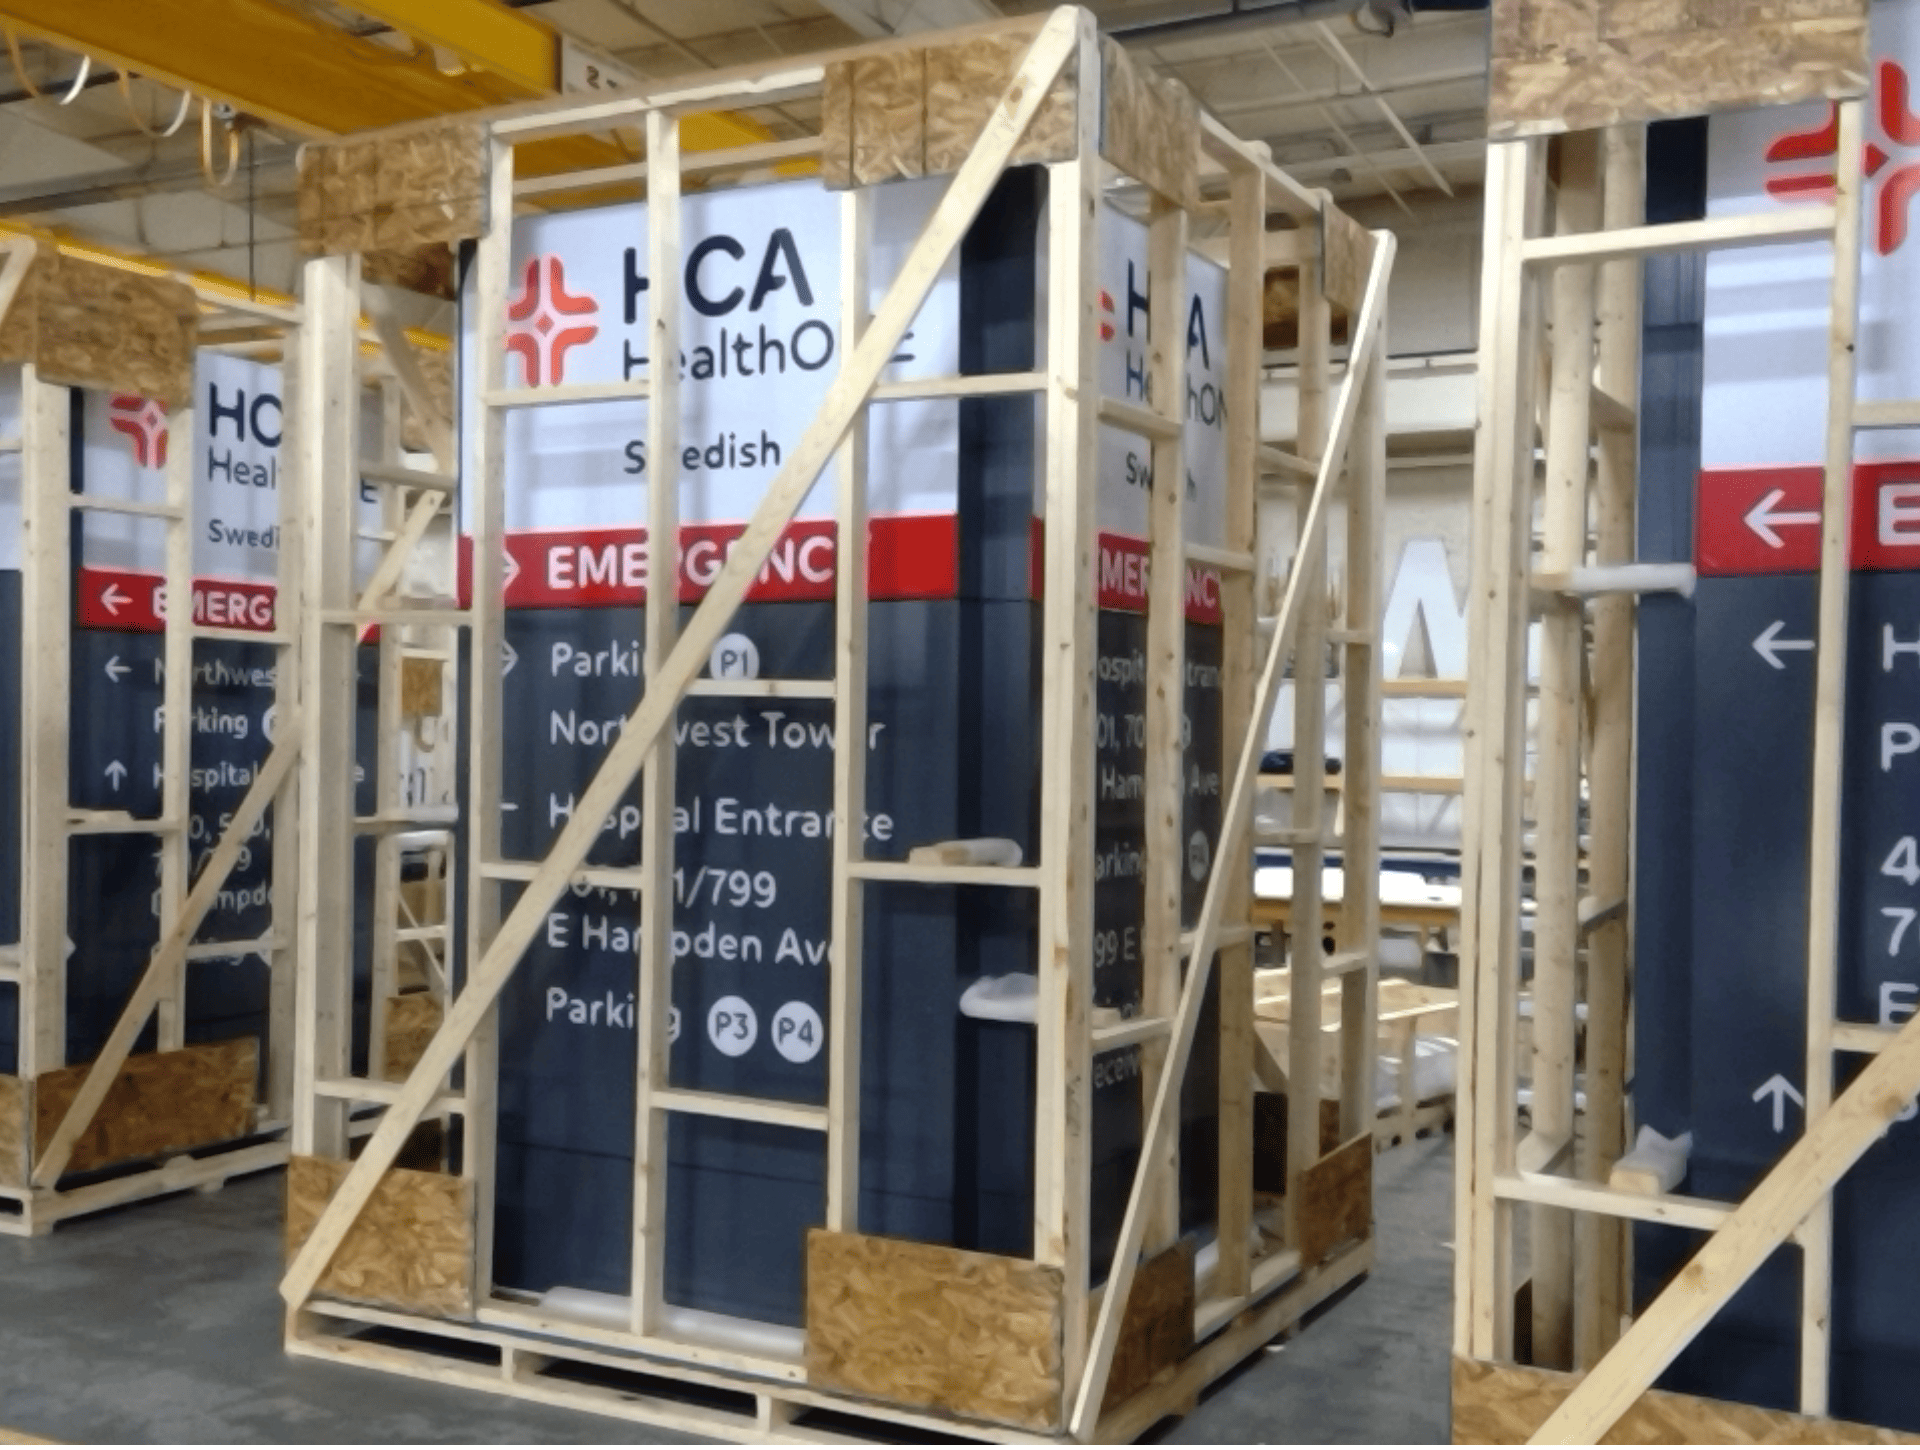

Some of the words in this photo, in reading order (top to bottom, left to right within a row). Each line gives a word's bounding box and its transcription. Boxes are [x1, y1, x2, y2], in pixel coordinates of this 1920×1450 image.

[624, 227, 815, 324] HCA
[1127, 258, 1210, 371] HA
[624, 319, 915, 383] HalthO
[209, 381, 284, 448] HC
[624, 429, 781, 474] Sedish
[208, 519, 280, 549] Swedi
[548, 535, 834, 590] EMEGNC
[551, 640, 640, 678] Parki
[720, 649, 749, 677] P1
[759, 710, 887, 750] Towr
[548, 912, 570, 948] E
[774, 926, 832, 966] Av
[545, 985, 682, 1045] Parkig
[714, 1010, 749, 1040] P3
[778, 1016, 813, 1048] P4
